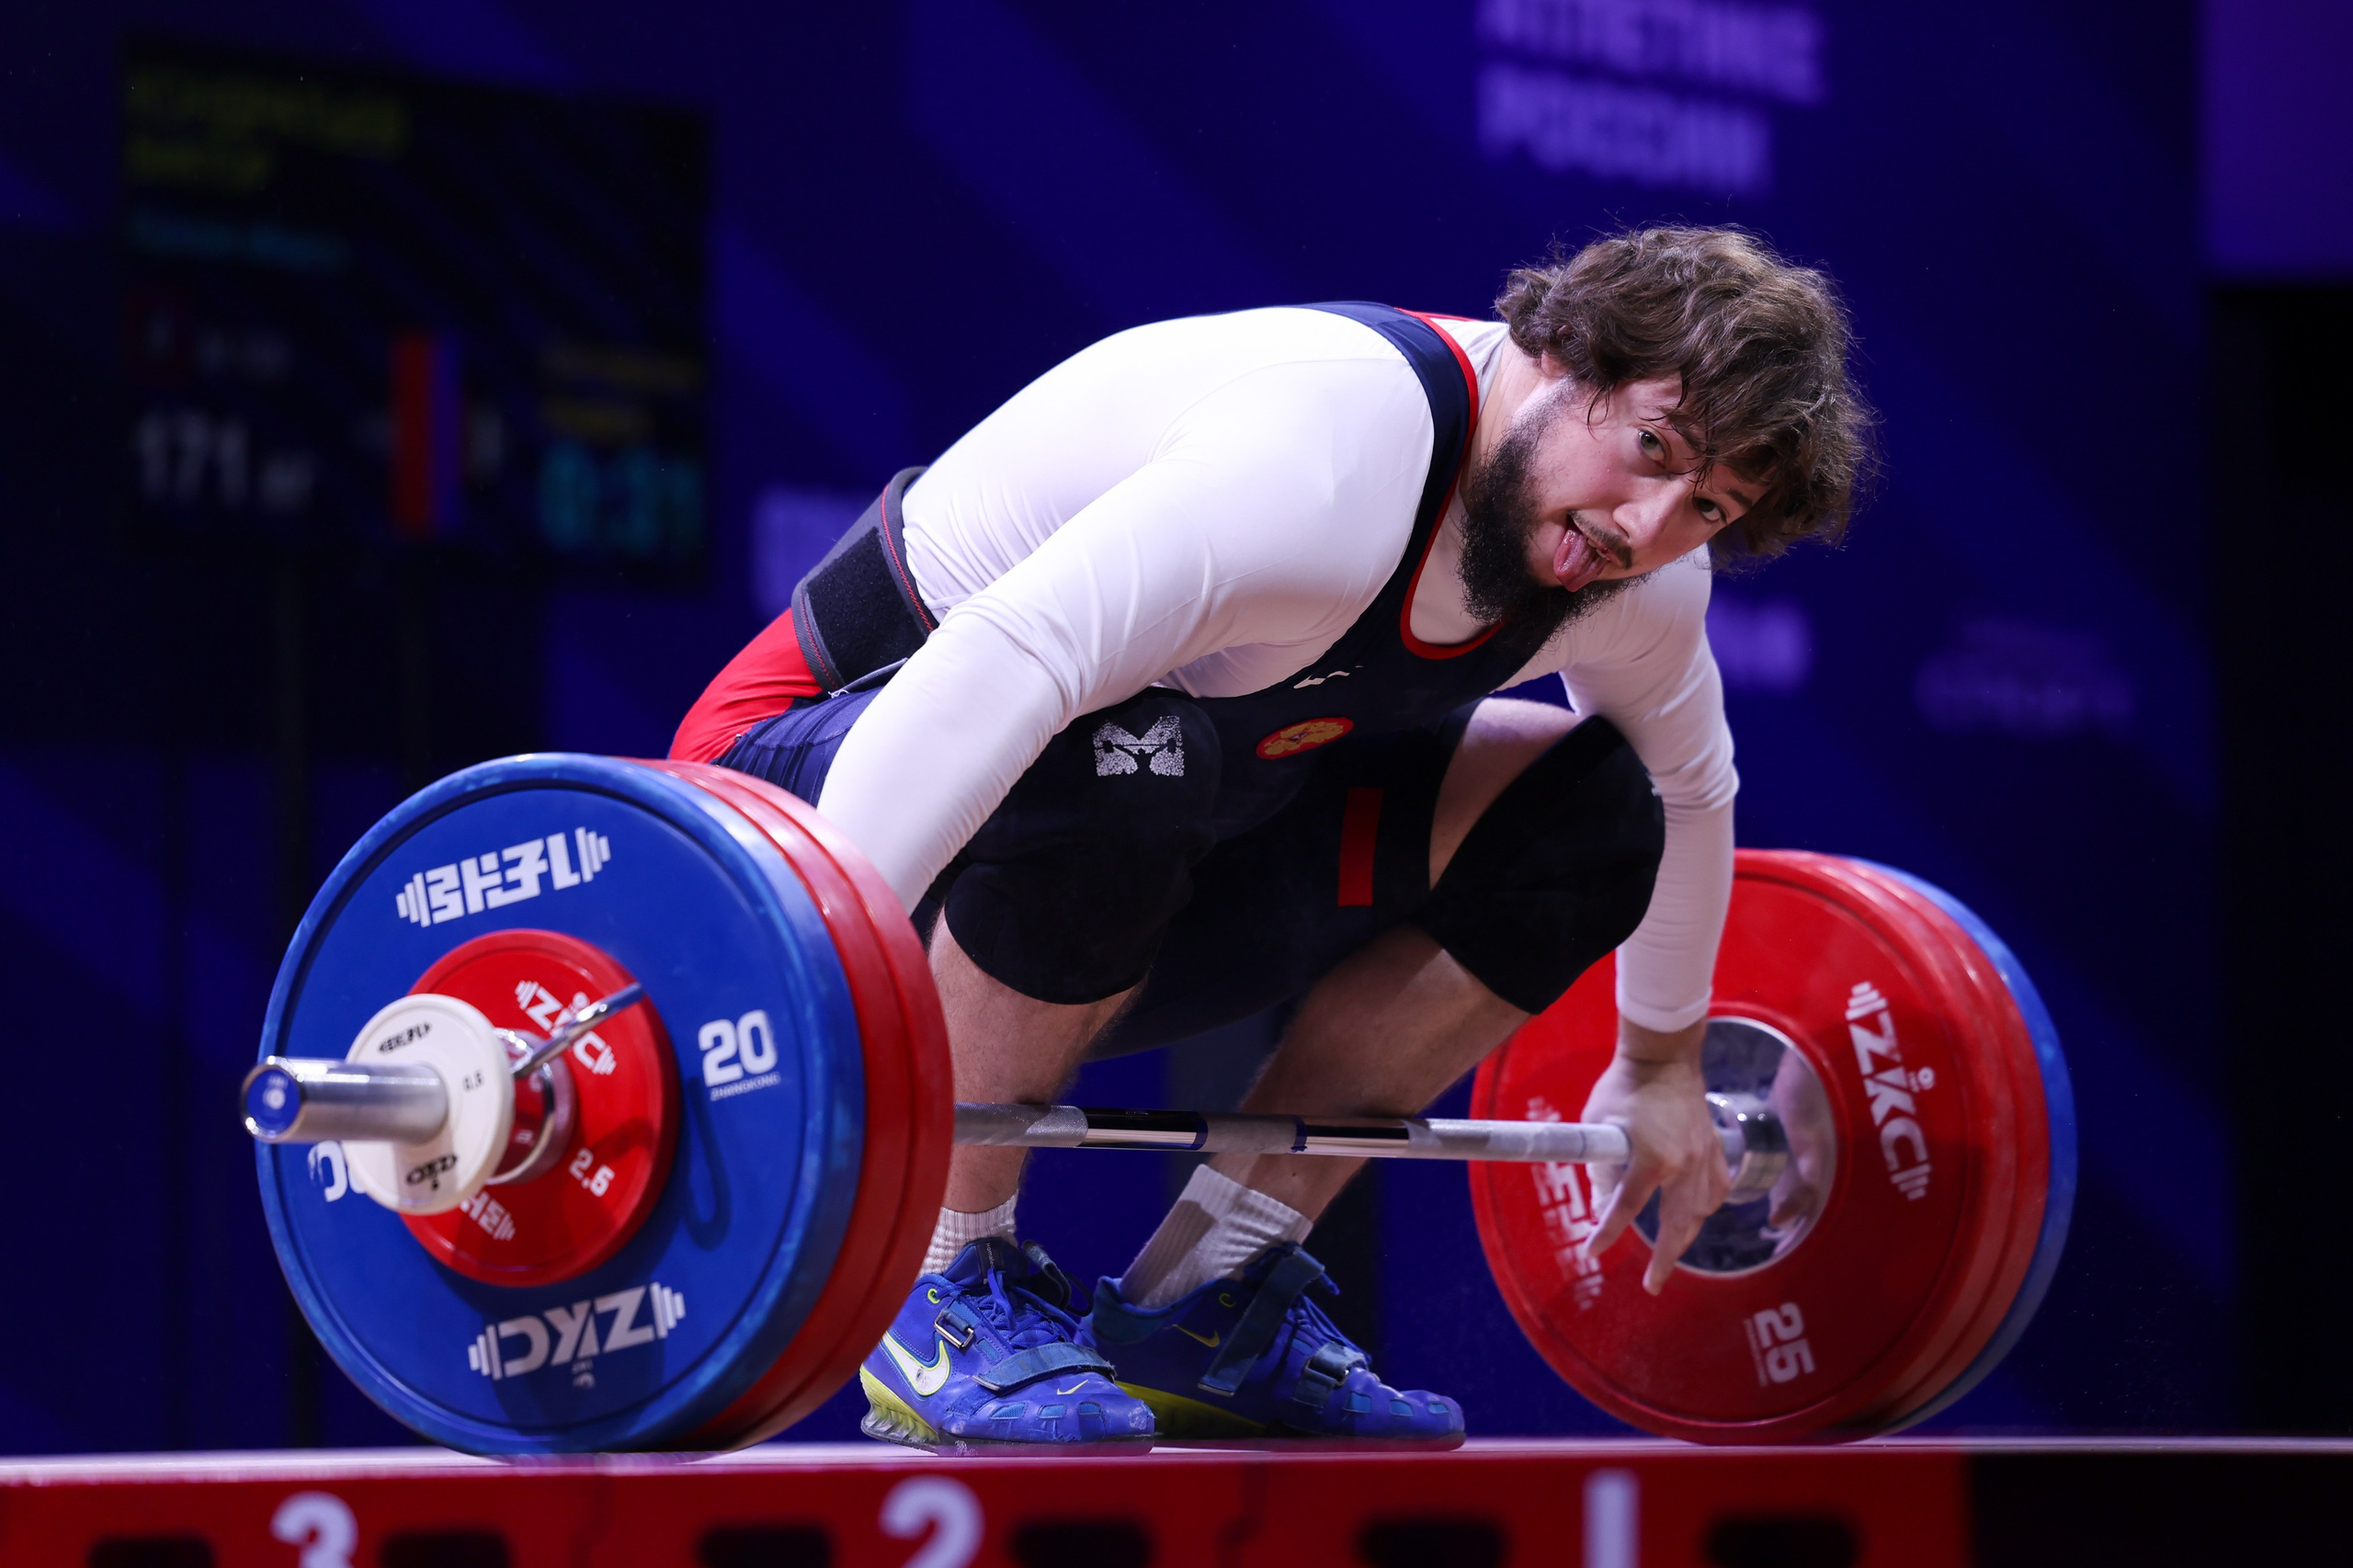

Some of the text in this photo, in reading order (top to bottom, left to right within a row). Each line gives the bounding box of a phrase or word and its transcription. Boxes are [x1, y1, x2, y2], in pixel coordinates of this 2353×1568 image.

[699, 1009, 778, 1087] 20
[1848, 1010, 1927, 1172] ZKC
[985, 1242, 995, 1269] Romaleo
[498, 1285, 655, 1378] ZKC
[1754, 1302, 1815, 1383] 25
